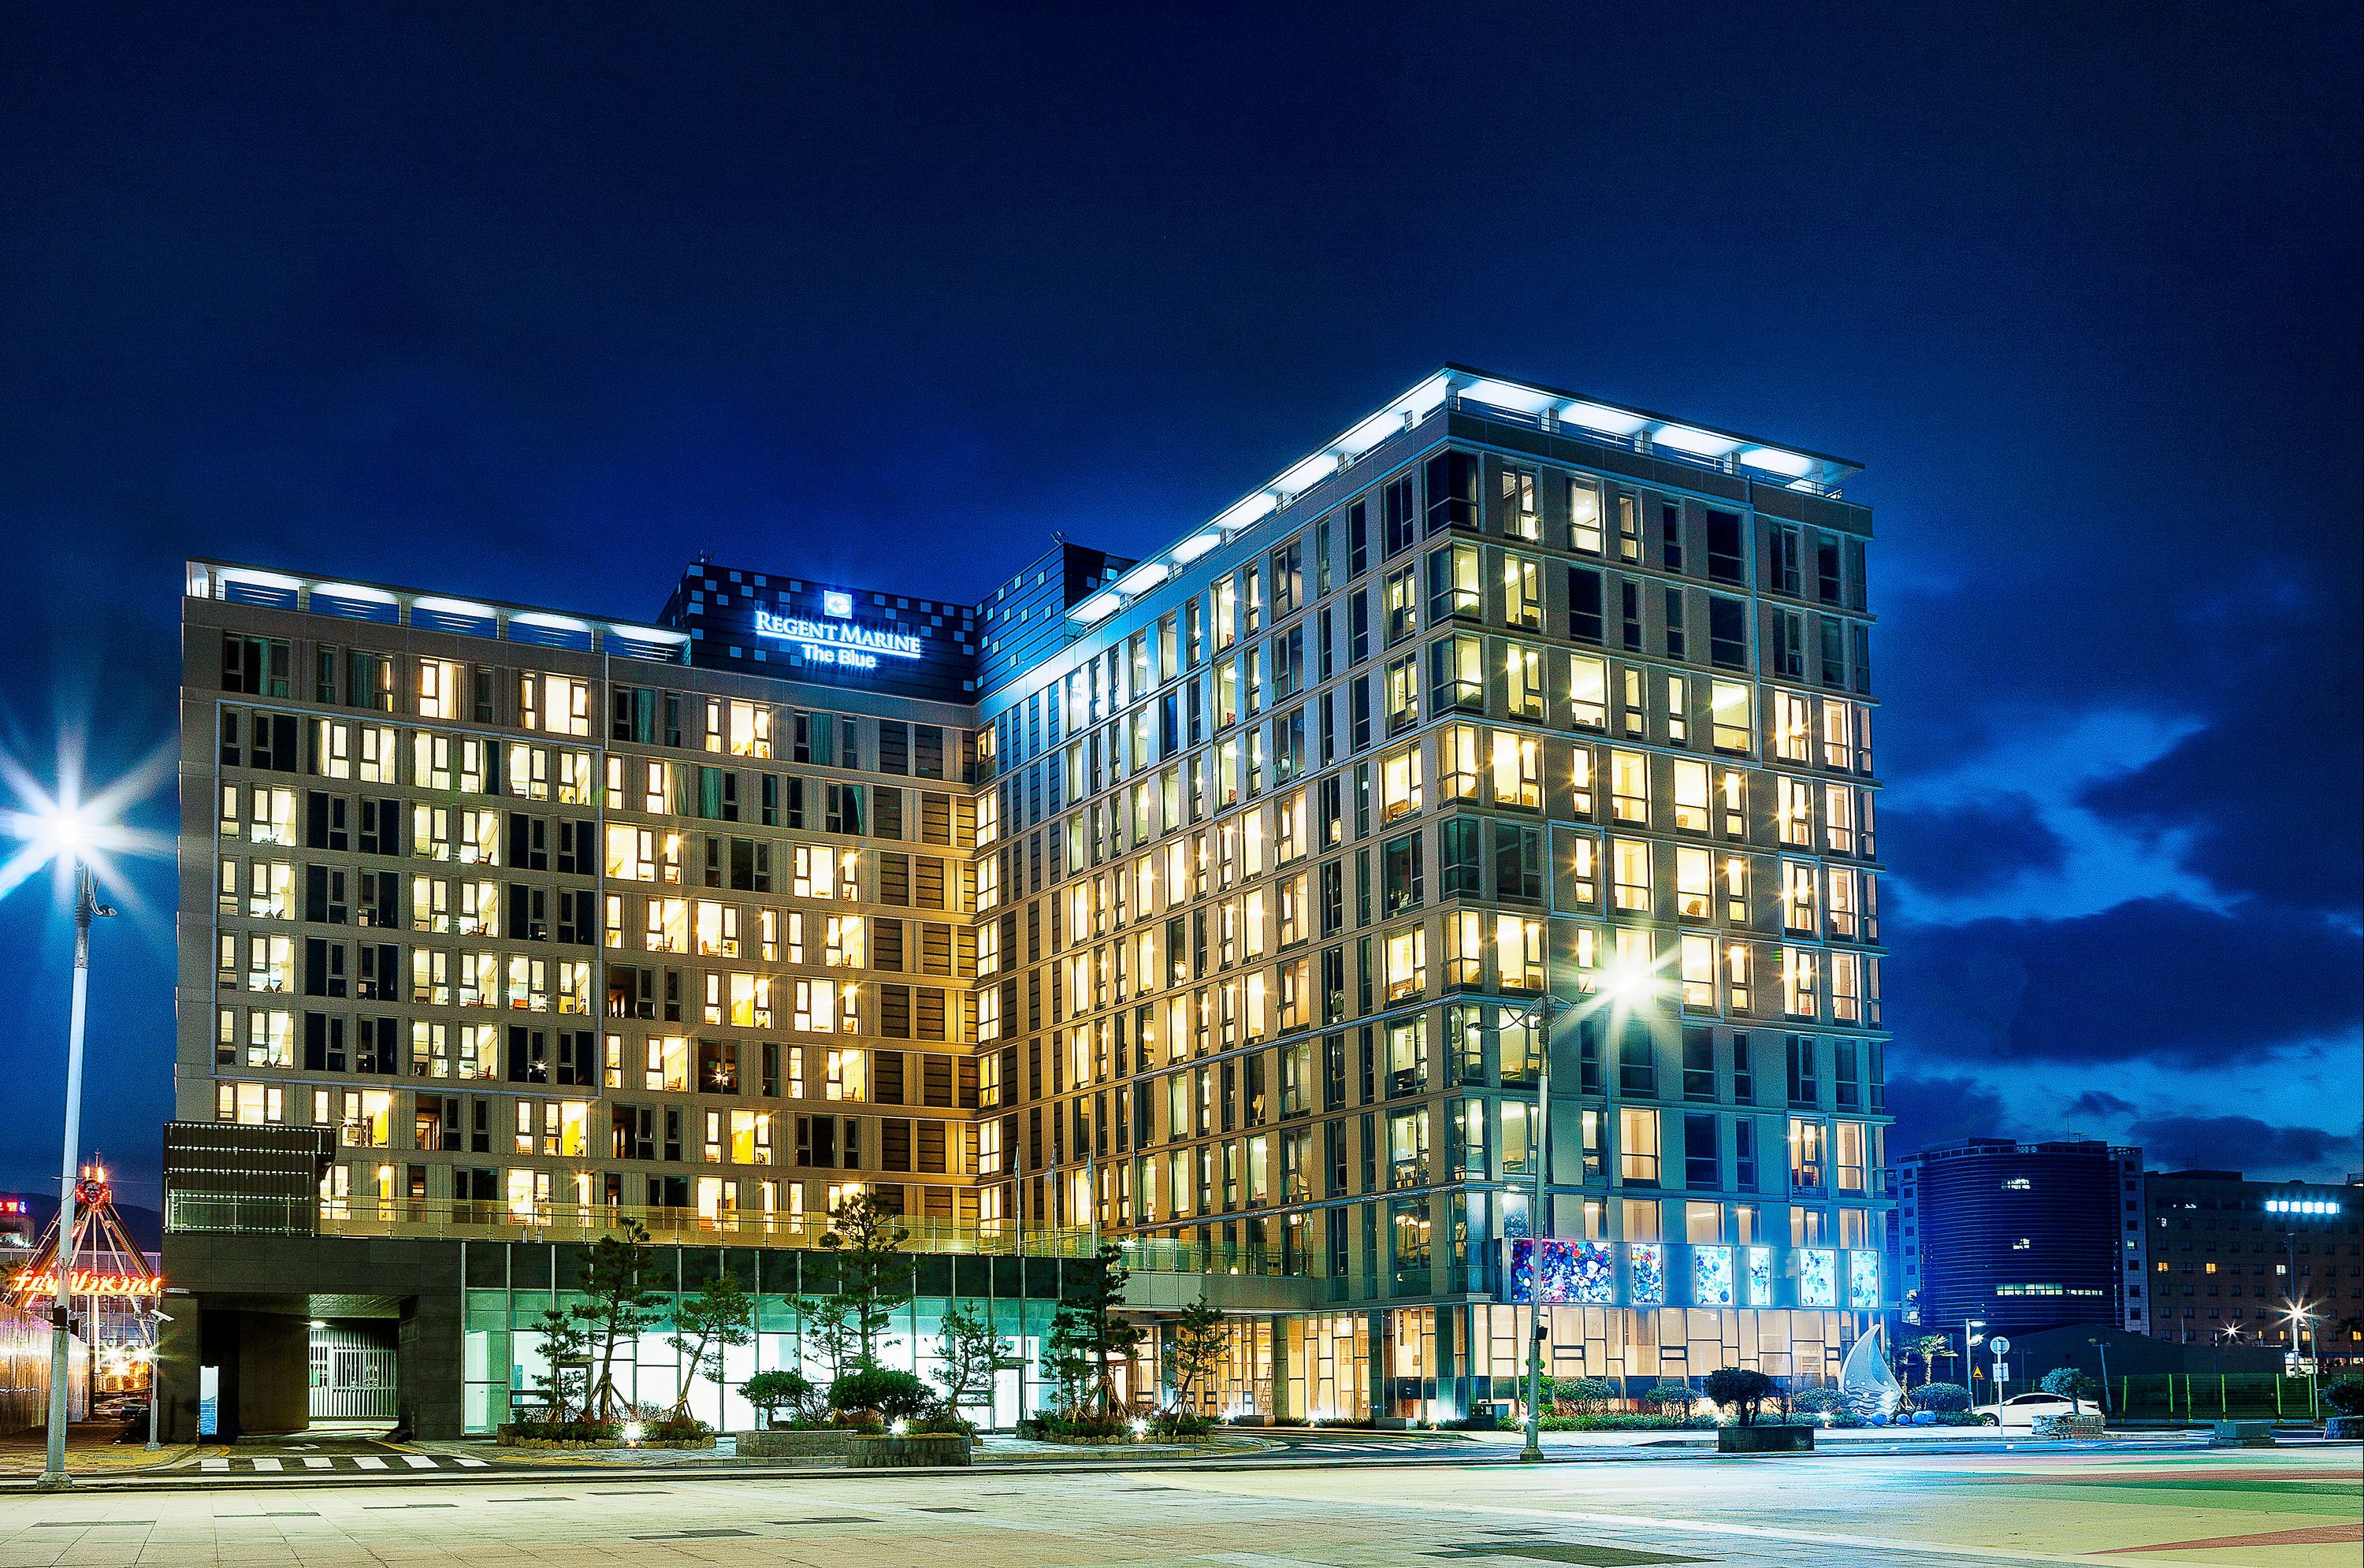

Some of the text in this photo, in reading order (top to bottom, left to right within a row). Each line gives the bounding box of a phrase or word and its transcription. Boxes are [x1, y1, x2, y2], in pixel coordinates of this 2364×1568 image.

[755, 611, 921, 653] REGENT MARINE
[801, 644, 876, 669] The Blue
